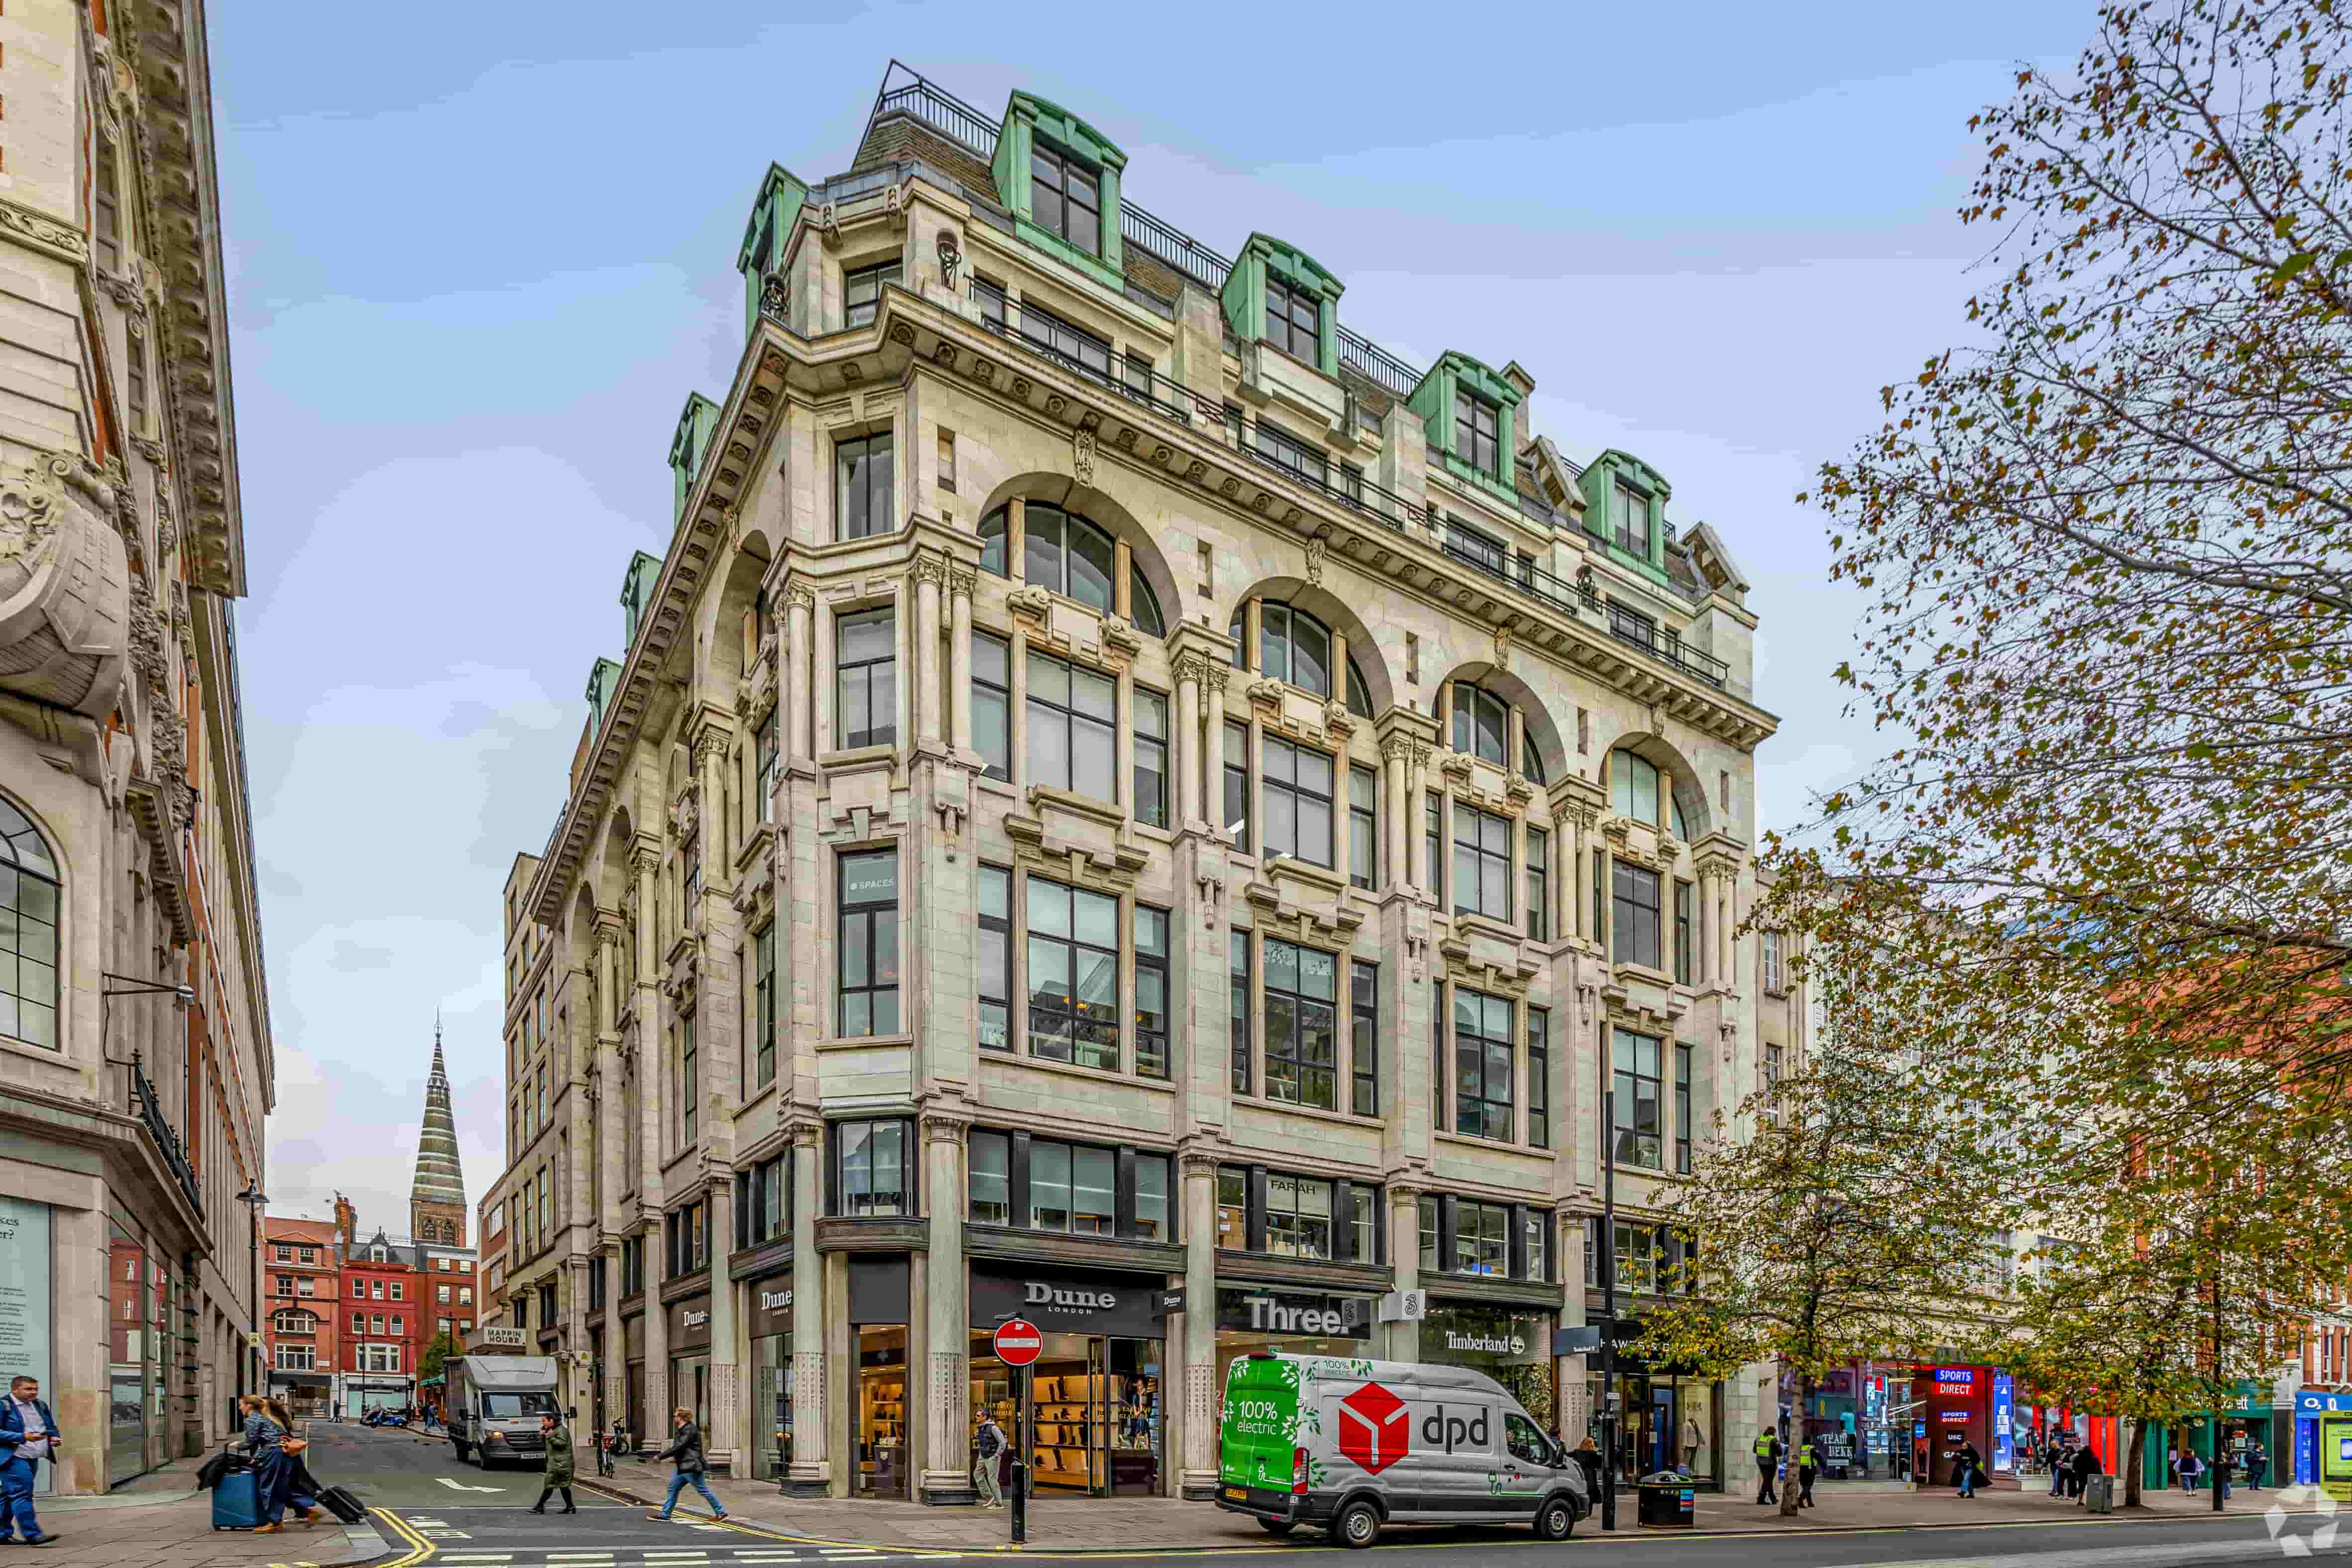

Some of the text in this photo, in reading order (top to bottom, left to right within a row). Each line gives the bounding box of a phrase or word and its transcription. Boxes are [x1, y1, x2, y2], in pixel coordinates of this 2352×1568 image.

[1271, 1179, 1315, 1195] FARAH
[761, 1290, 792, 1311] Dune
[1024, 1282, 1116, 1309] Dune
[1048, 1306, 1092, 1315] LONDON
[684, 1311, 705, 1327] Dune
[1445, 1330, 1509, 1353] Timberland
[1939, 1370, 1973, 1382] SPORTS
[1939, 1384, 1971, 1395] DIRECT
[1238, 1401, 1278, 1420] 100%
[1237, 1419, 1278, 1435] electric
[1422, 1404, 1489, 1454] dpd
